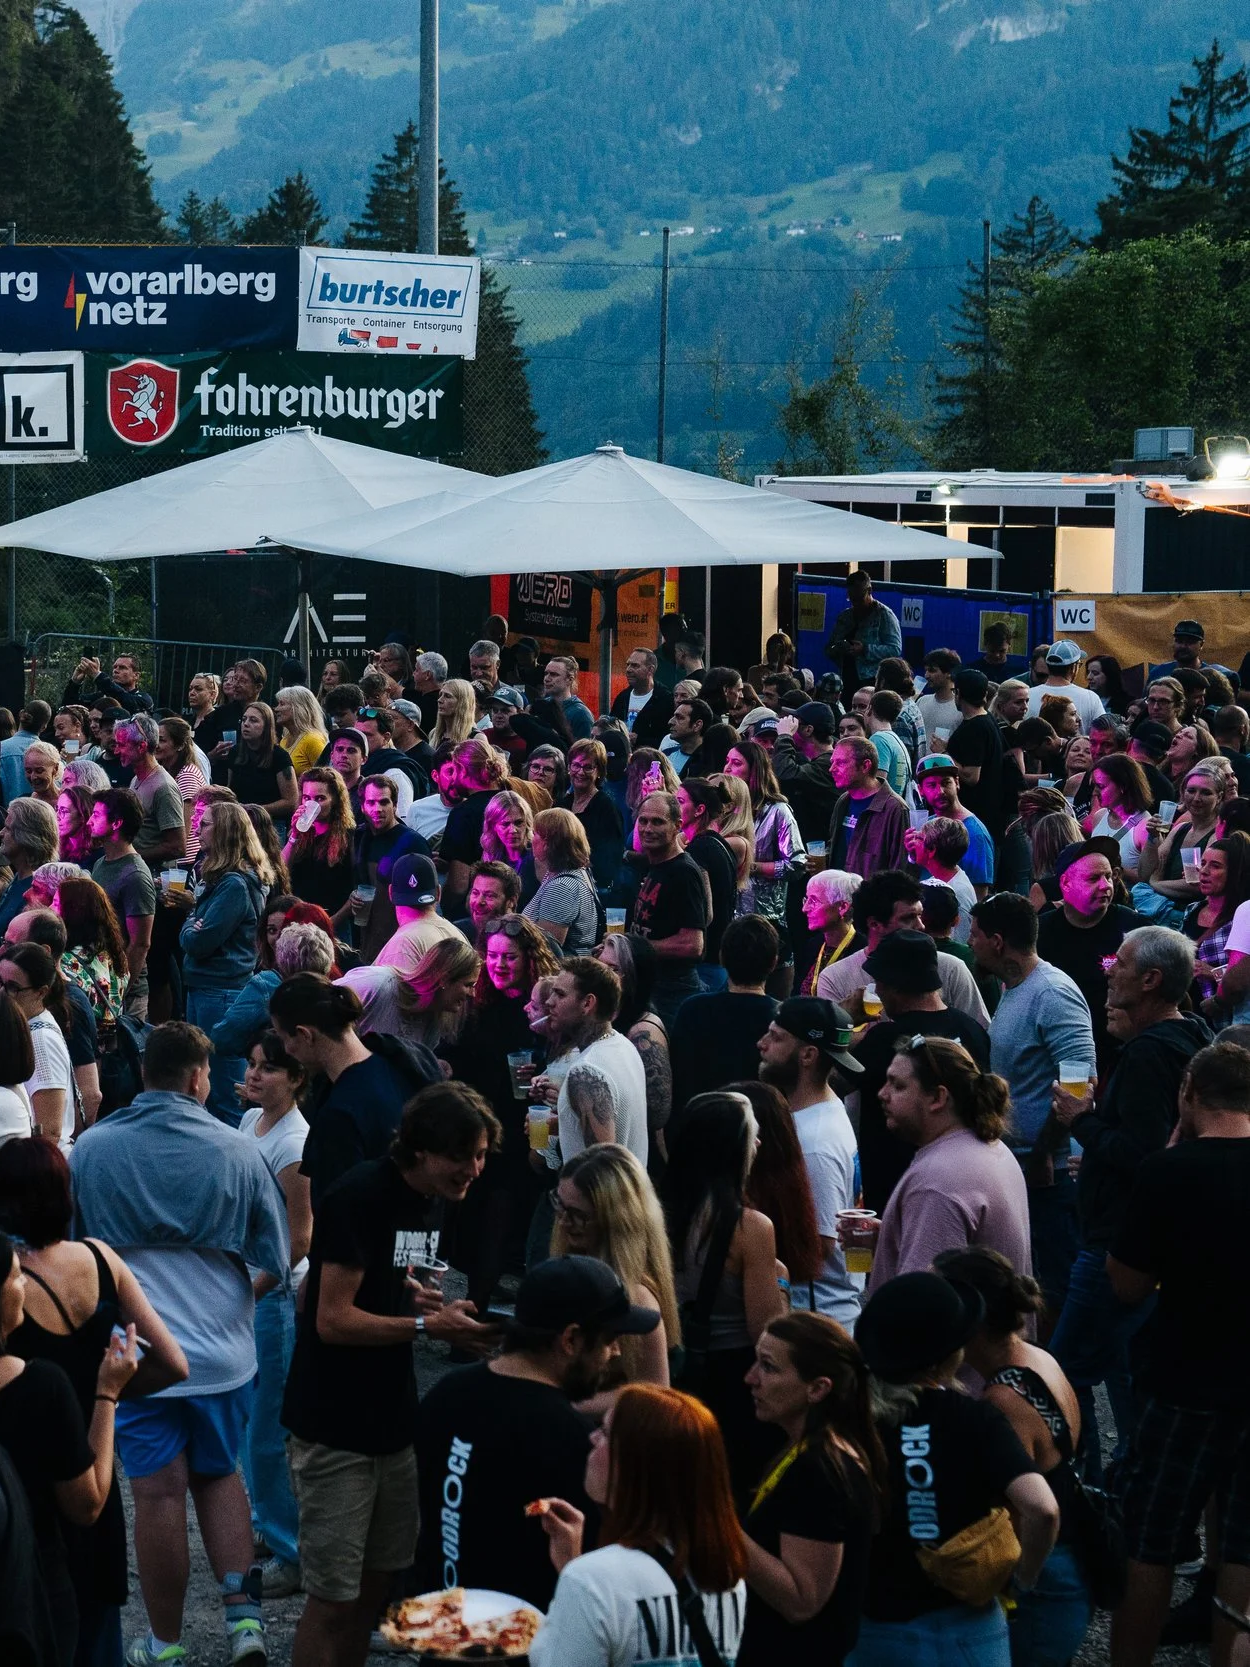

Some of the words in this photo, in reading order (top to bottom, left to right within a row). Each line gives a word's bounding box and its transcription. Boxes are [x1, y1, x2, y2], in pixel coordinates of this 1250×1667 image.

[86, 263, 276, 302] vorarlberg
[318, 272, 462, 310] burtscher
[88, 296, 167, 326] netz
[306, 314, 356, 326] Transporte
[362, 317, 406, 329] Container
[413, 320, 463, 333] Entsorgung
[11, 395, 49, 438] k.
[200, 424, 261, 437] Tradition
[264, 425, 288, 437] seit
[904, 606, 921, 622] WC
[1060, 608, 1091, 625] WC
[283, 648, 368, 658] ARHITEKTUR
[901, 1424, 940, 1540] ODROCK
[441, 1436, 473, 1590] OODROCK
